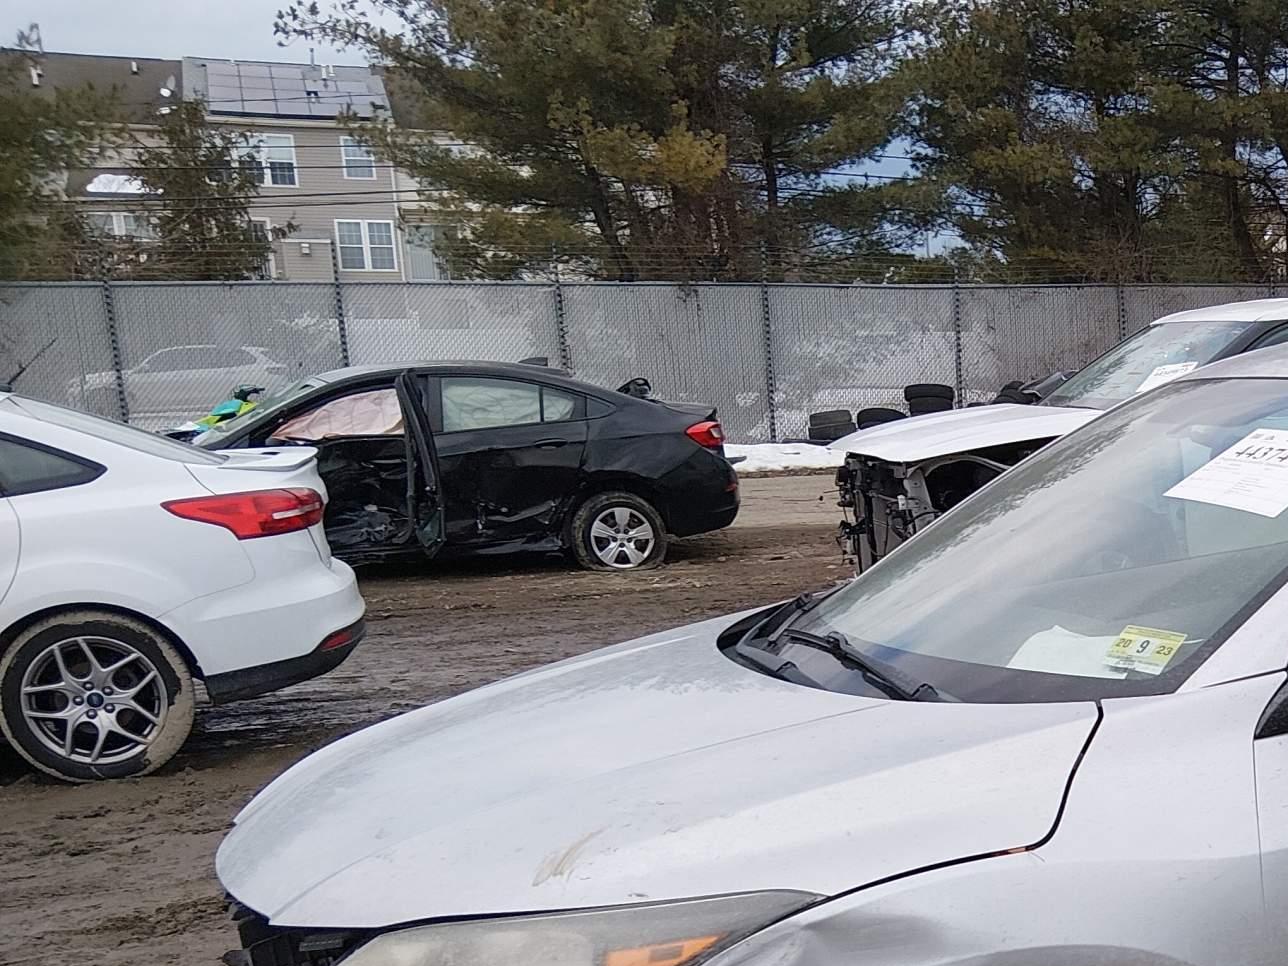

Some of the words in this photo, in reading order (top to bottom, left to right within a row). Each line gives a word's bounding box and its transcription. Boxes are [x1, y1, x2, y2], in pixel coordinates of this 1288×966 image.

[1115, 638, 1132, 648] 20
[1136, 639, 1150, 653] 9
[1156, 645, 1173, 655] 23
